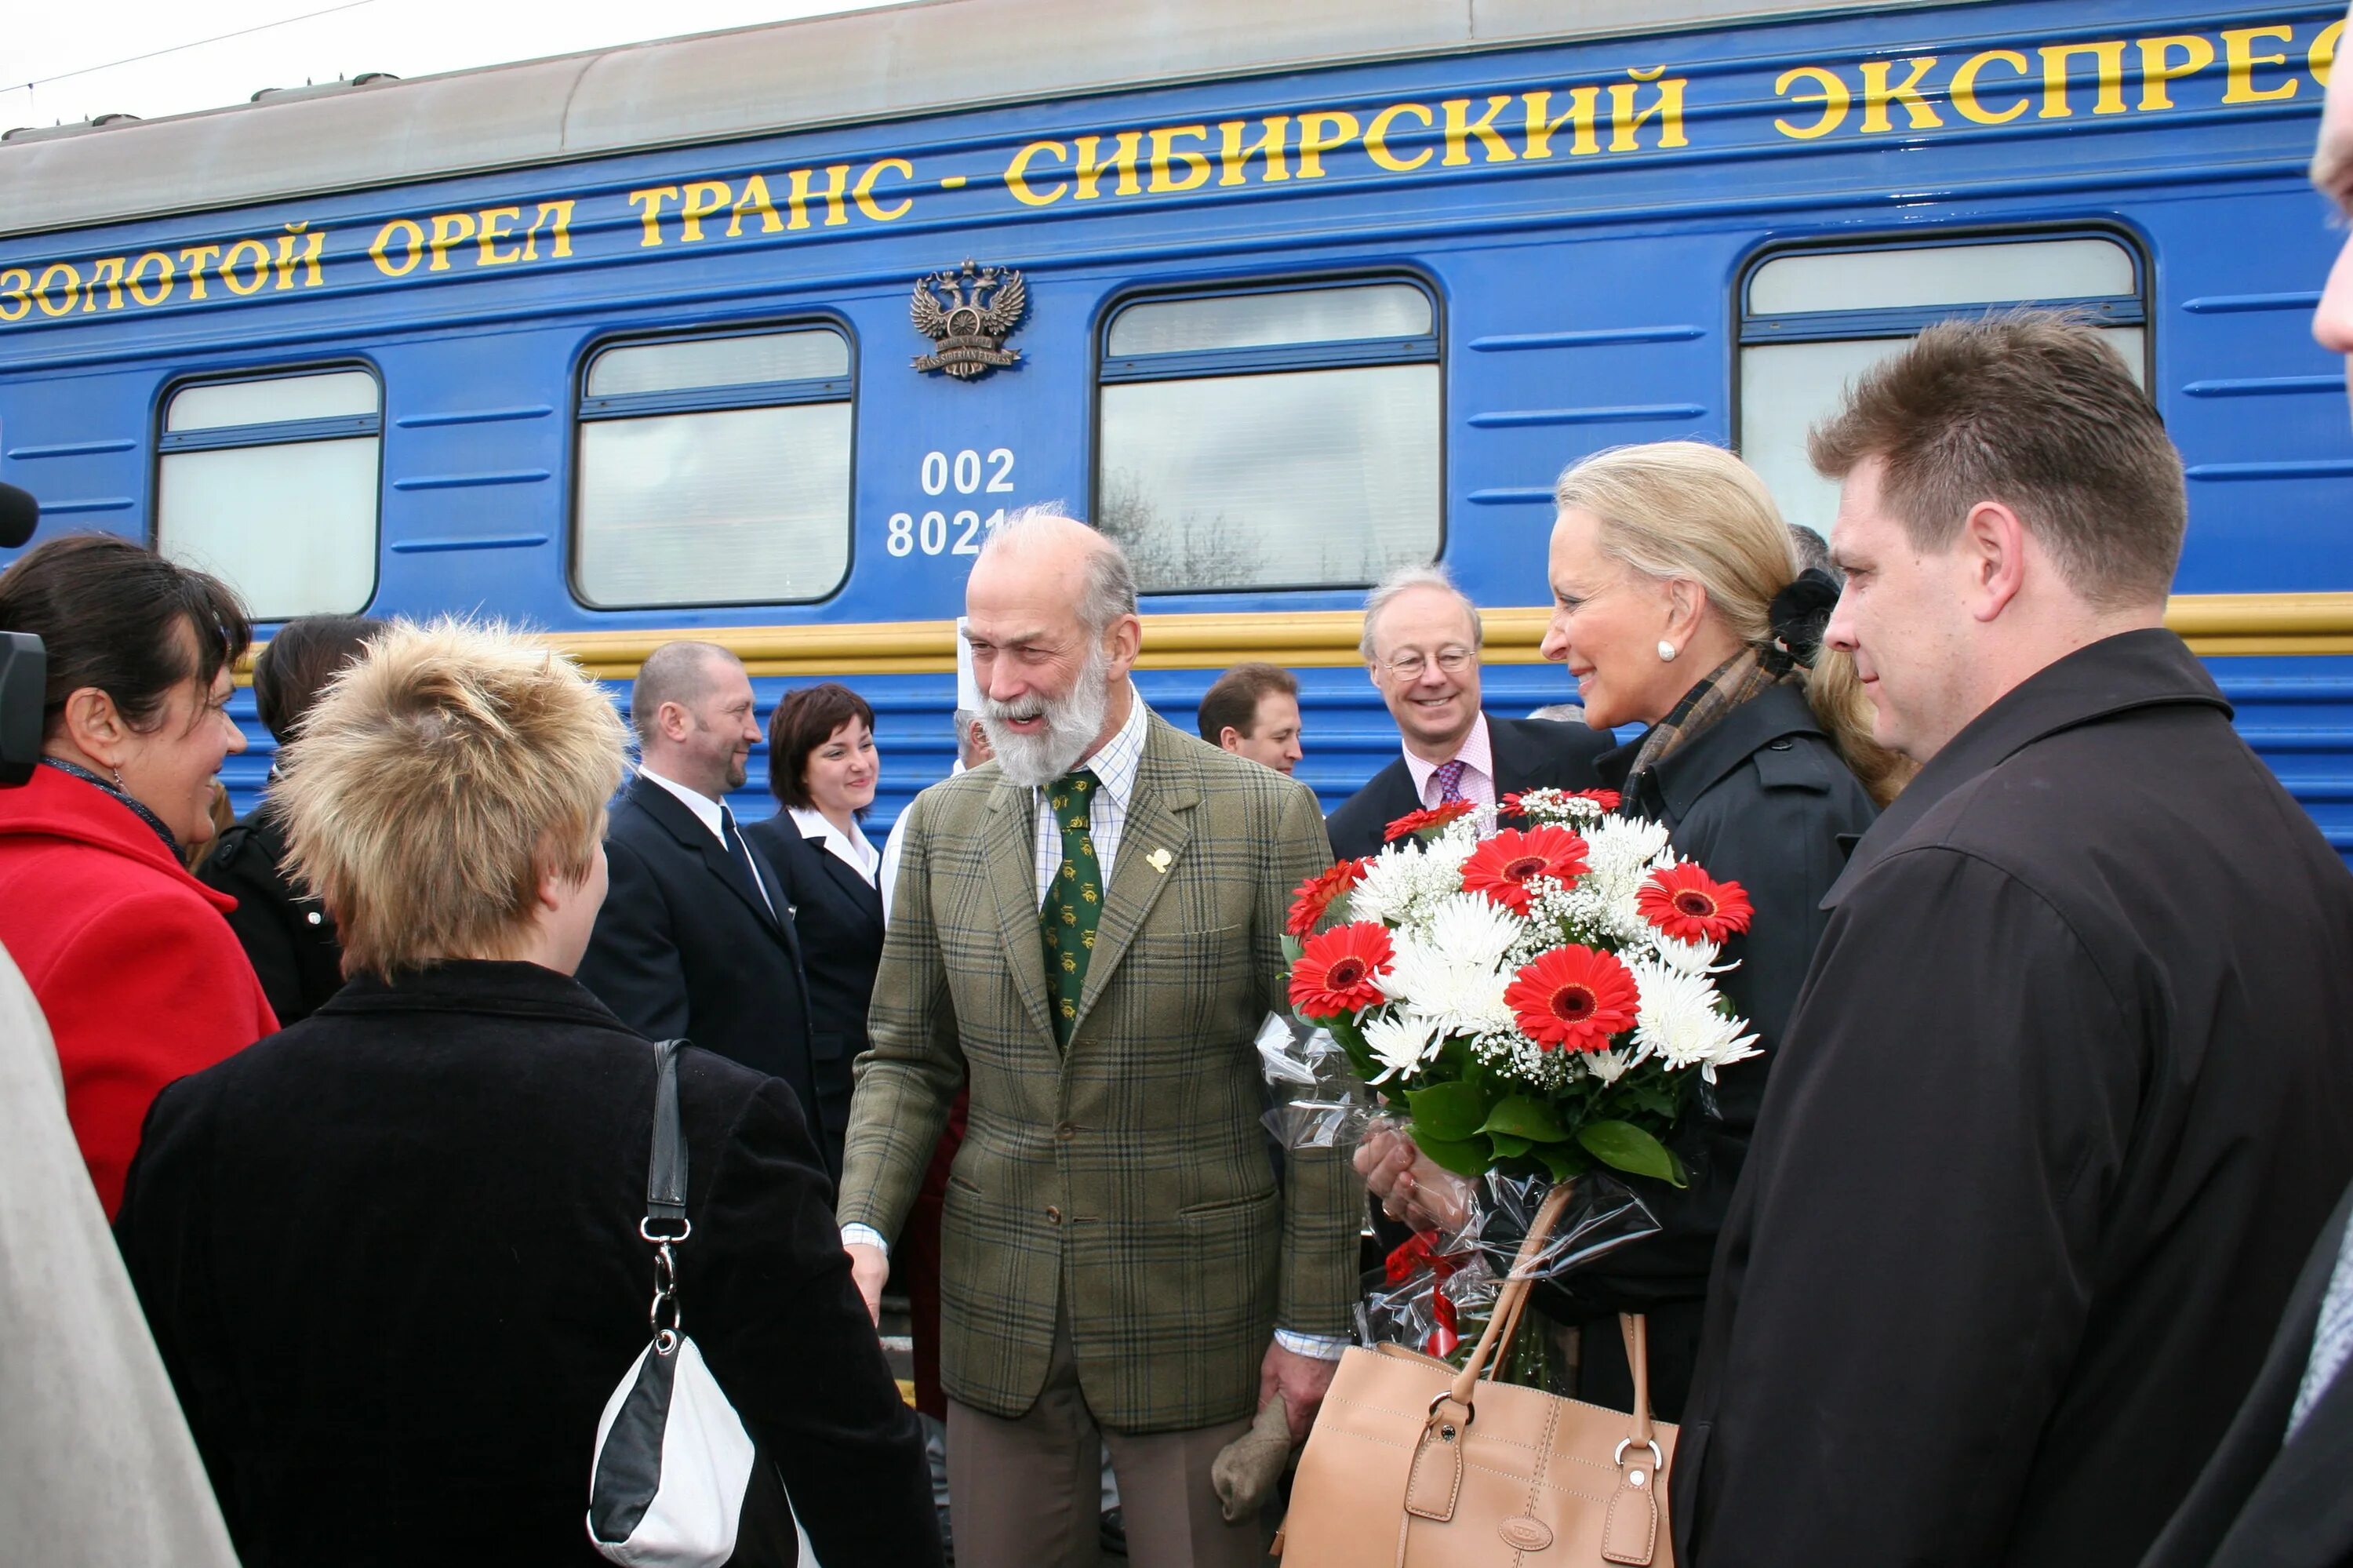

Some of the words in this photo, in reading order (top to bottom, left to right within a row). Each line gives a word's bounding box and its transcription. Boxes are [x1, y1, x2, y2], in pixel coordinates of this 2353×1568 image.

[0, 220, 325, 321] ЗОЛОТОЙ
[368, 200, 576, 276] ОРЕЛ
[628, 158, 913, 248] ТРАНС
[1003, 65, 1689, 206] СИБИРСКИЙ
[940, 351, 977, 363] SIBERIAN
[978, 351, 1012, 365] EXPRESS
[921, 448, 1016, 496] 002
